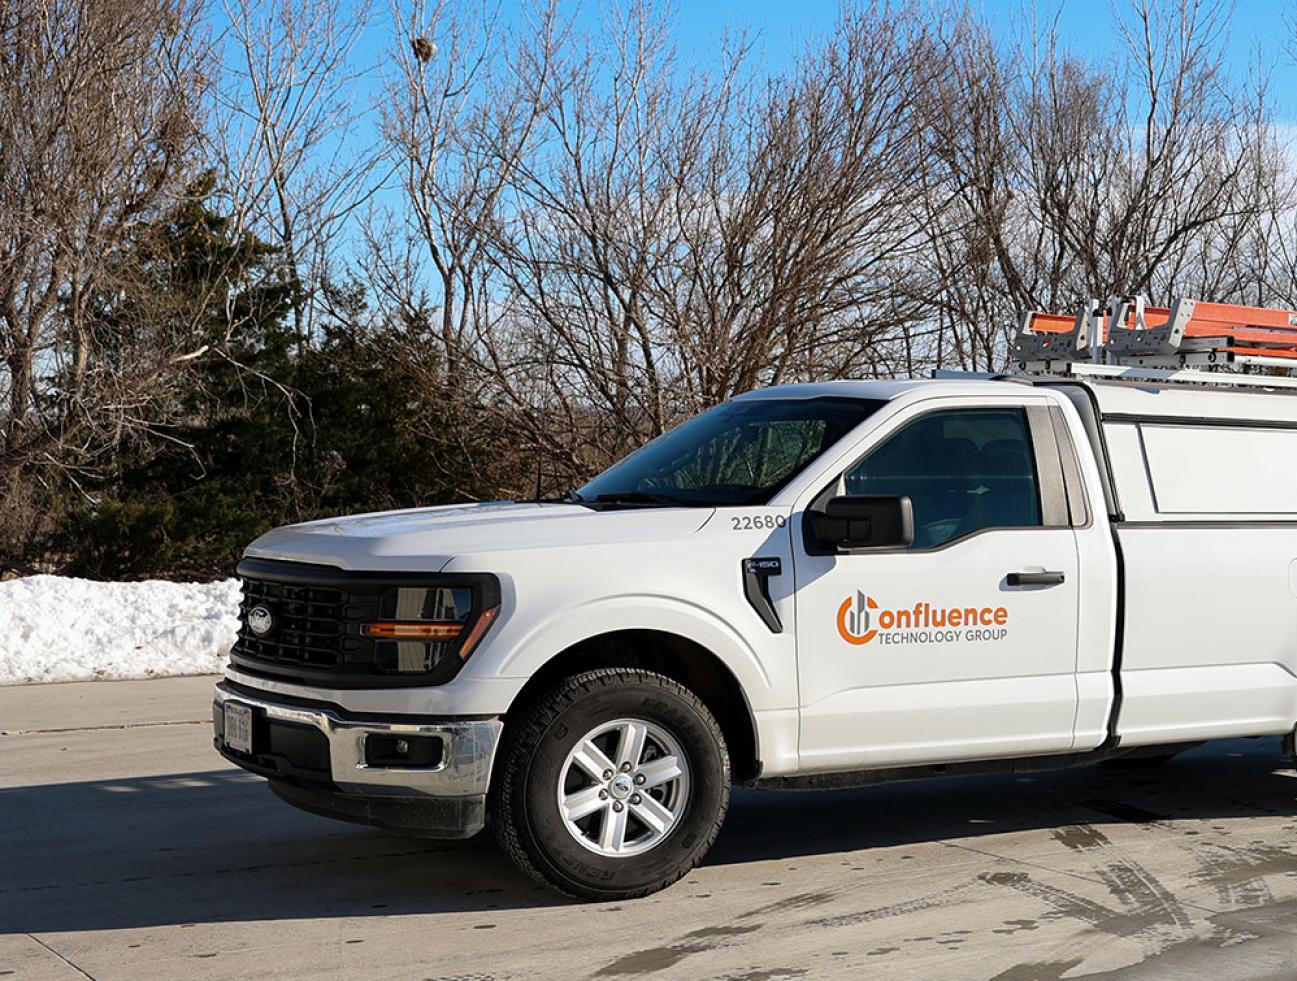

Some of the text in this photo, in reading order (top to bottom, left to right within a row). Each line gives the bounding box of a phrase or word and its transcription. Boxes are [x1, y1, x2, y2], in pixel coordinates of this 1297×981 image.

[731, 514, 787, 530] 22680
[836, 589, 1008, 646] Confluence
[878, 629, 1008, 645] TECHNOLOGY GROUP
